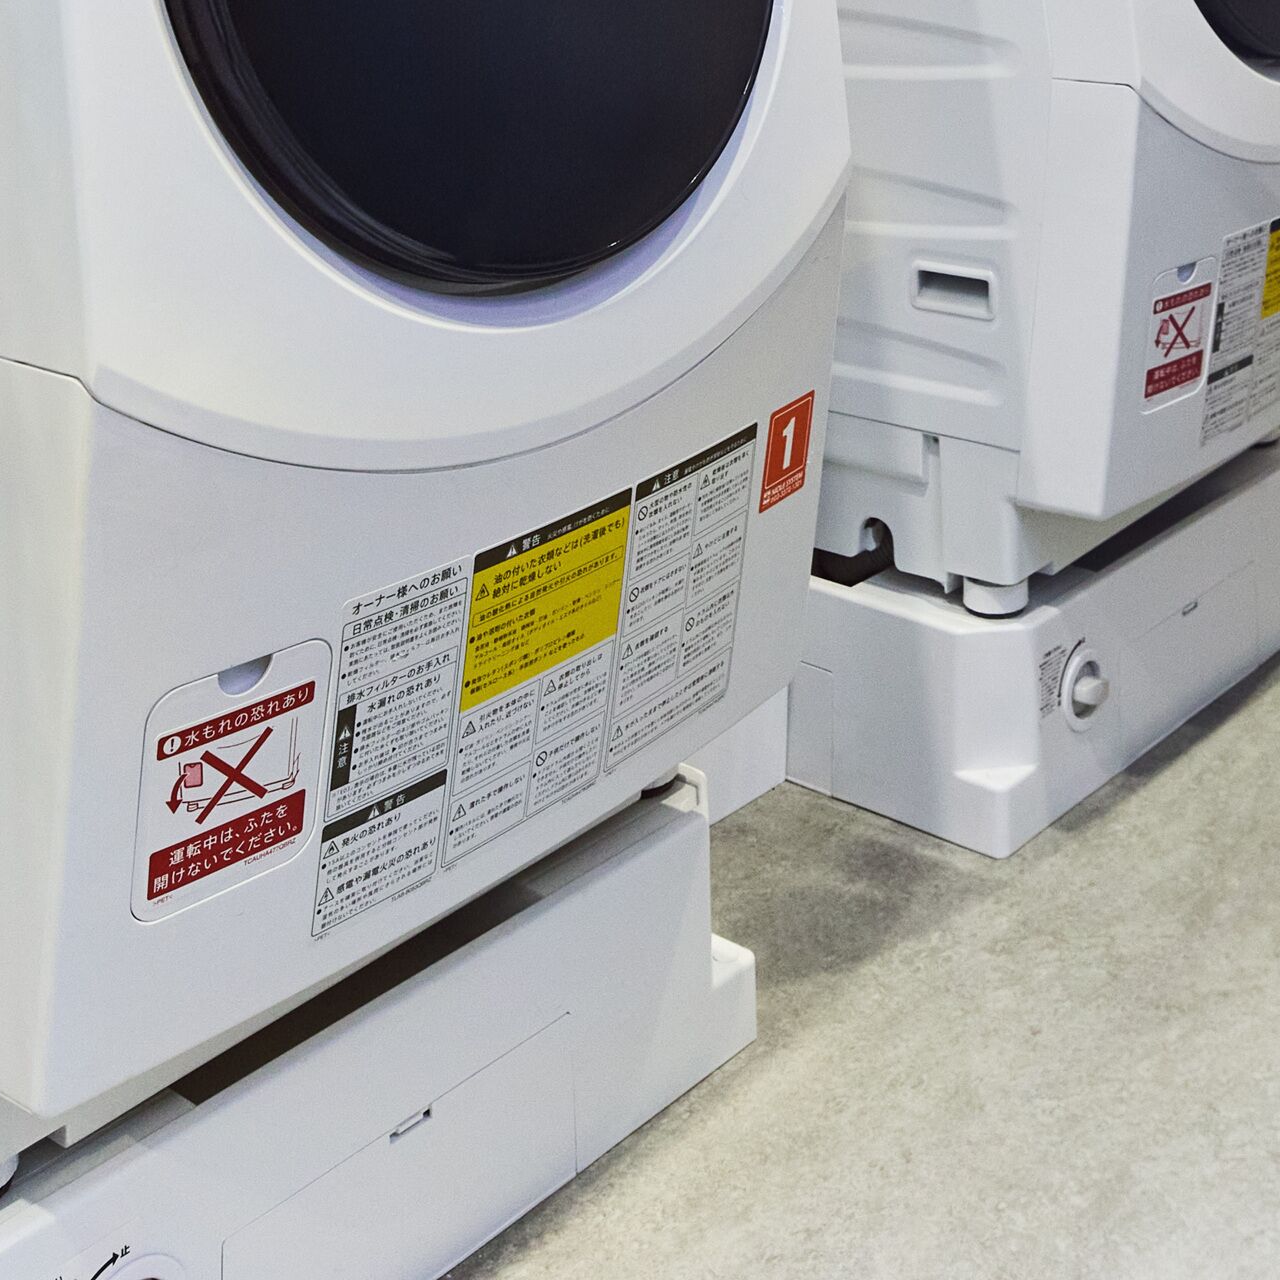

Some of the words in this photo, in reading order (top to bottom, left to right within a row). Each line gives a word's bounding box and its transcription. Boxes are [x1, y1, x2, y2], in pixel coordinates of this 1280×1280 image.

[782, 416, 796, 470] 1
[664, 469, 680, 485] 注意
[522, 533, 541, 550] 警告
[352, 564, 462, 615] オーナー様へのお願い
[492, 561, 562, 599] 絶対に乾燥しない
[352, 585, 459, 635] 日常点検・清掃のお願い
[346, 654, 450, 704] 排水フィルターのお手入れ
[367, 674, 441, 713] 水漏れの恐れあり
[185, 687, 309, 747] 水もれの恐れあり
[337, 742, 349, 769] 注意
[383, 794, 406, 812] 警告
[169, 804, 288, 867] 運転中は、ふたを
[341, 812, 401, 848] 発火の恐れあり
[153, 822, 298, 893] 開けないでください。
[120, 1245, 130, 1258] 止
